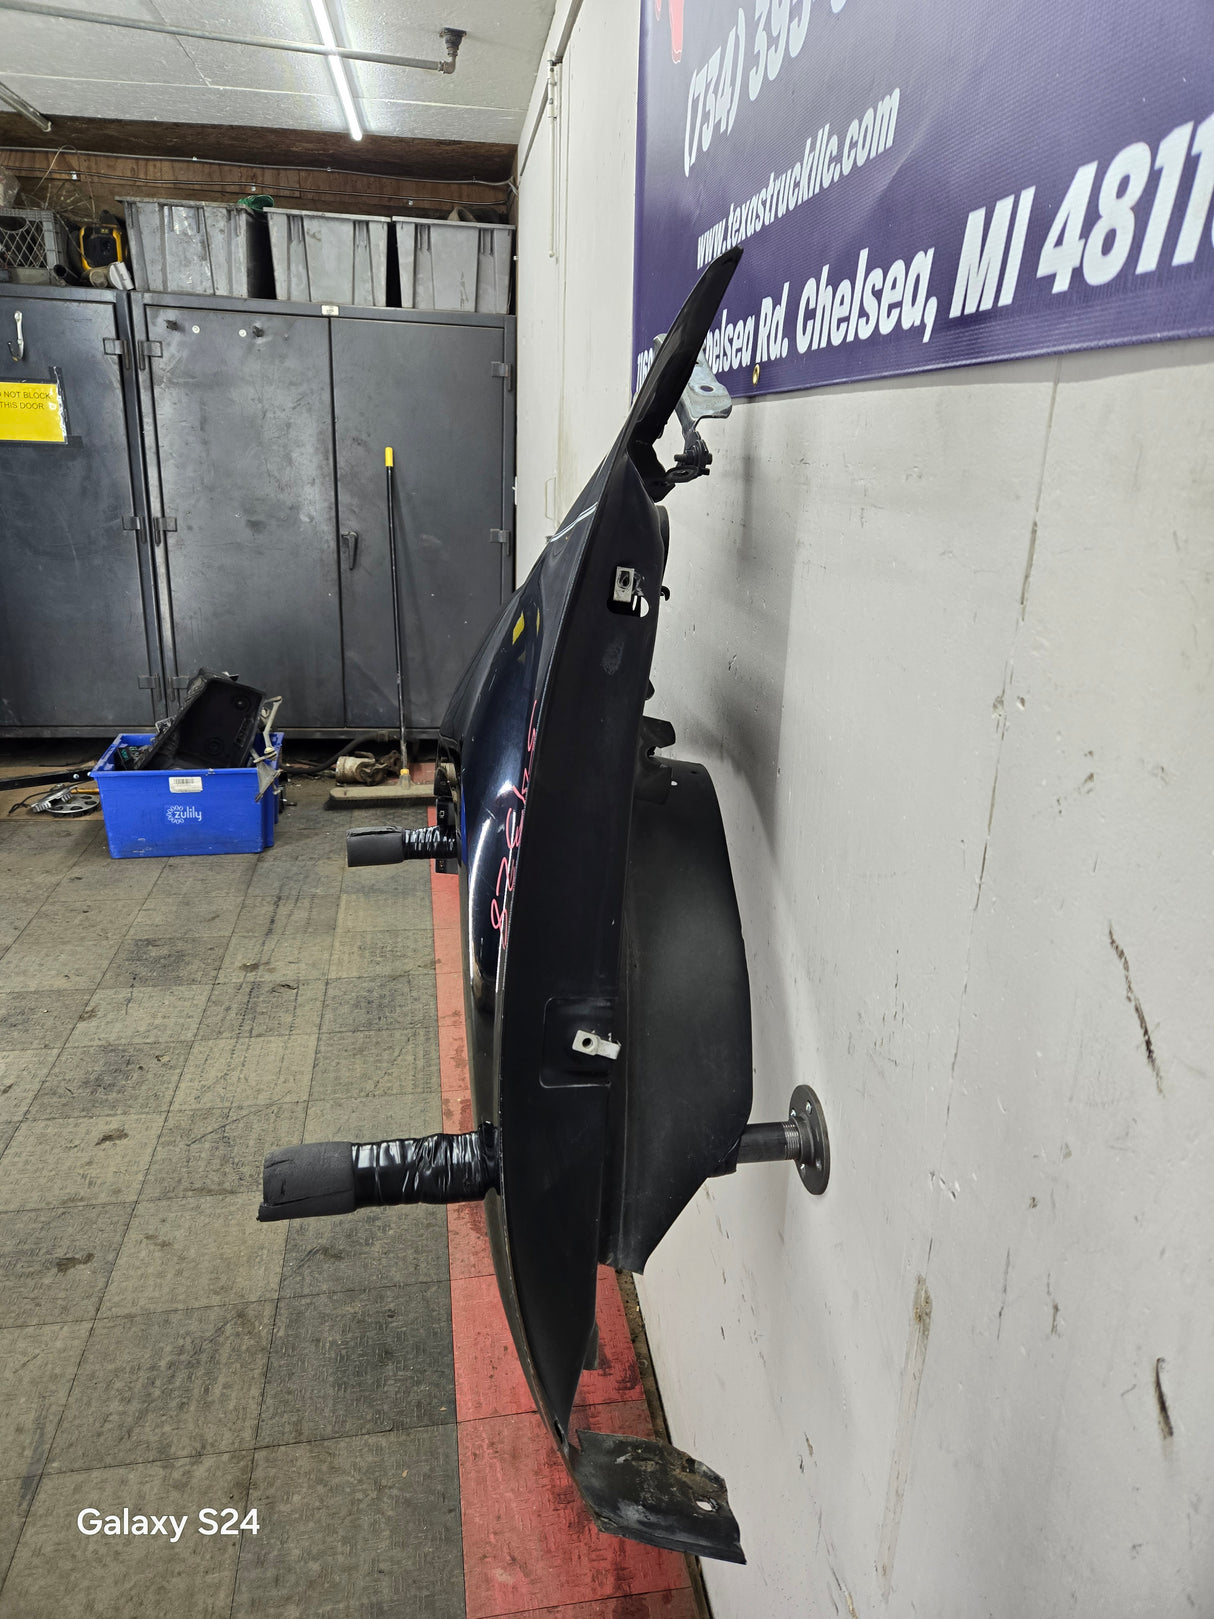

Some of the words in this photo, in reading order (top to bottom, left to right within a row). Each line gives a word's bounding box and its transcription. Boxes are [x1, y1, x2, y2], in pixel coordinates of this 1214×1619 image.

[684, 8, 746, 178] (734)
[697, 88, 900, 270] www.texastruckllc.com
[703, 308, 755, 375] helsea
[756, 281, 790, 363] Rd.
[797, 247, 938, 354] Chelsea,
[949, 185, 1036, 319] MI
[1036, 111, 1214, 294] 4811
[174, 806, 203, 821] zulily
